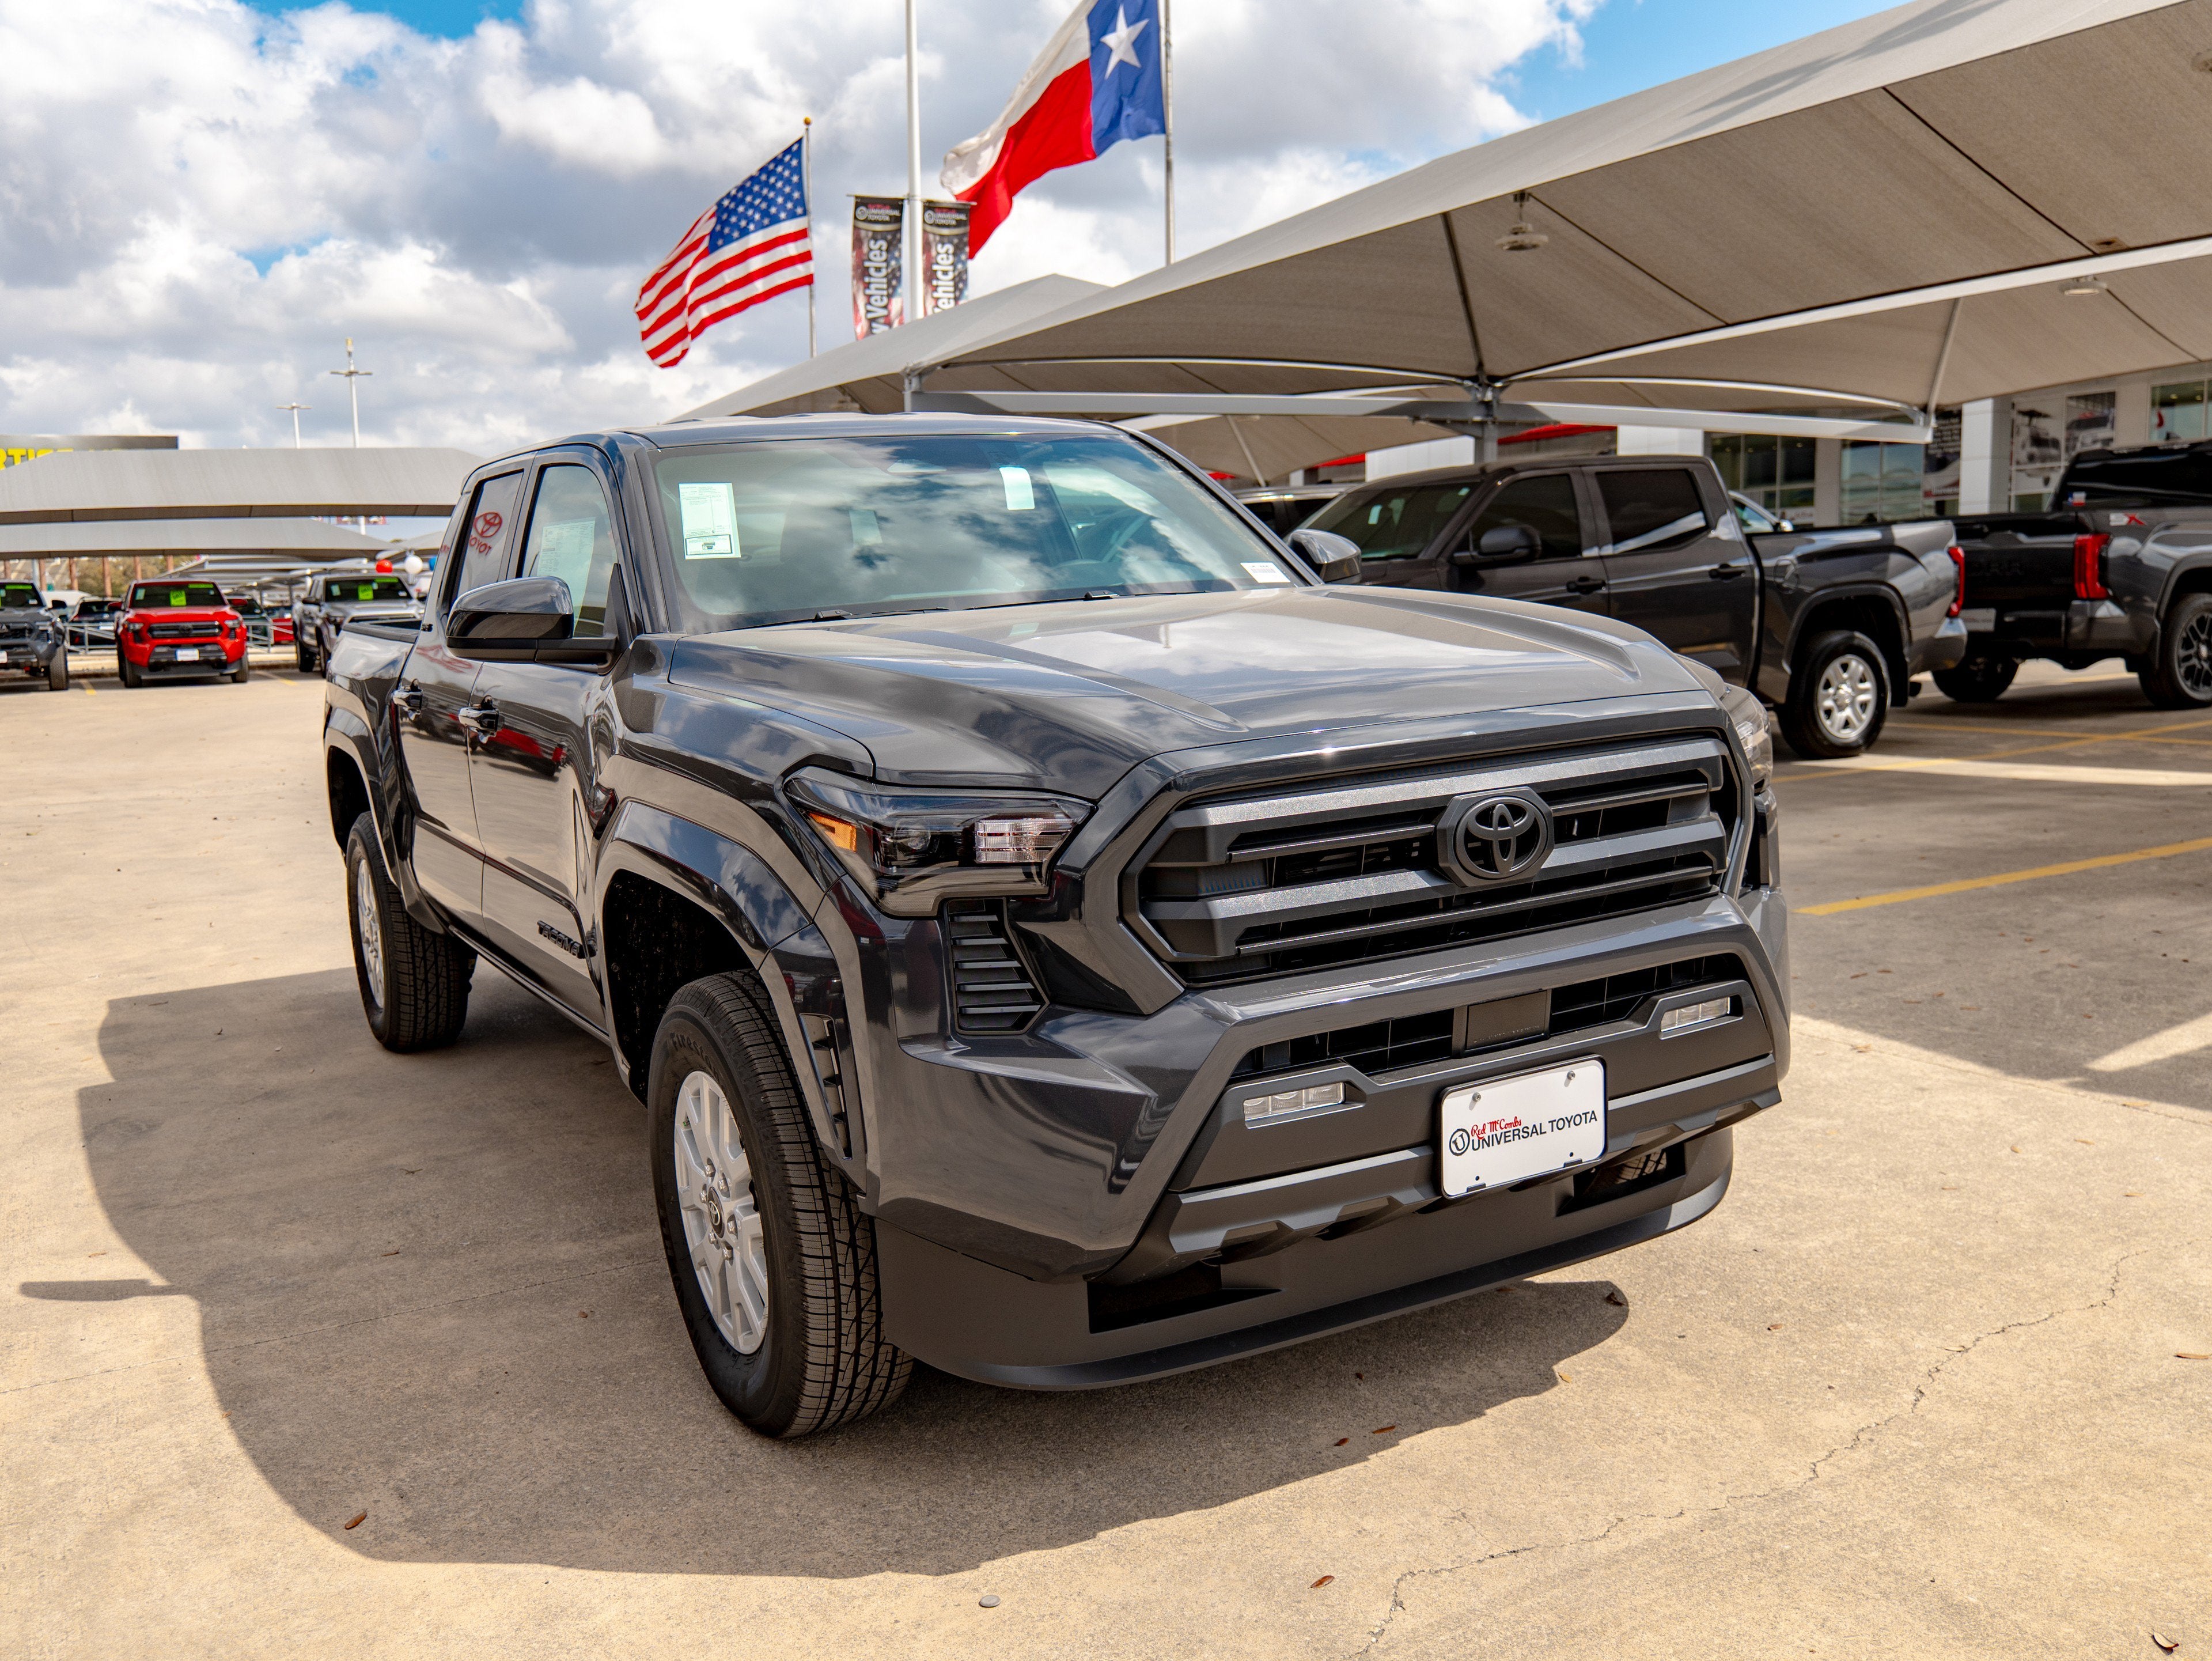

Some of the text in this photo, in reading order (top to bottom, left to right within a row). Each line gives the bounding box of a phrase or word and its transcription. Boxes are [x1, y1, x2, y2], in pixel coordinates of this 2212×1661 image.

[863, 239, 889, 319] Vehicles
[537, 920, 583, 959] TACOMA
[1471, 1116, 1522, 1140] Red McCombs
[1471, 1123, 1547, 1151] UNIVERSAL
[1548, 1110, 1597, 1132] TOYOTA
